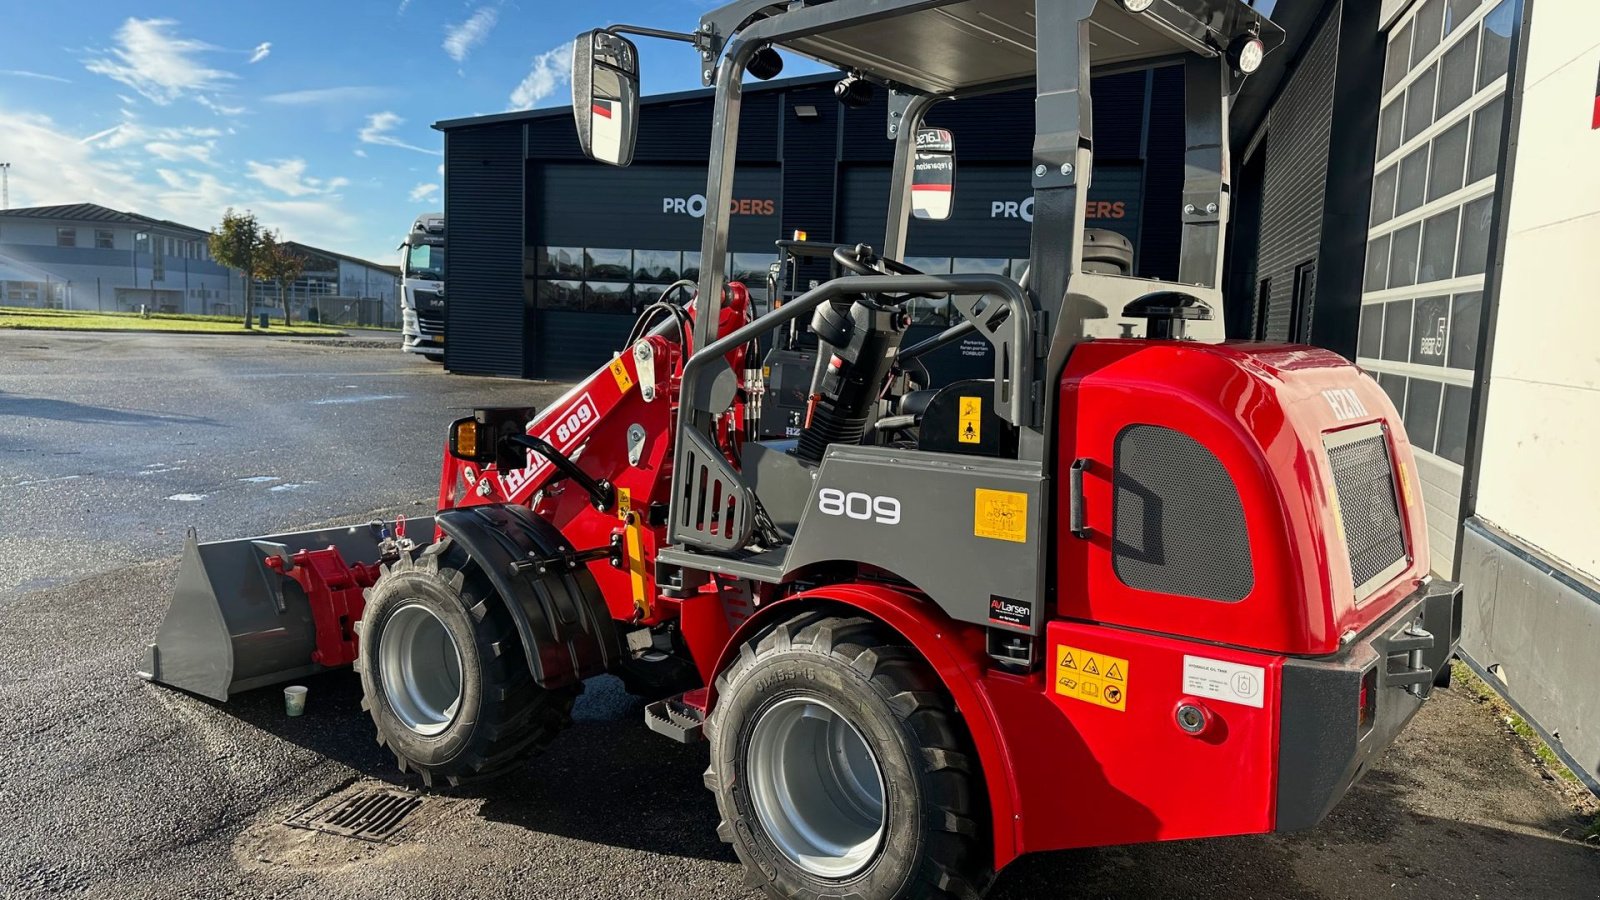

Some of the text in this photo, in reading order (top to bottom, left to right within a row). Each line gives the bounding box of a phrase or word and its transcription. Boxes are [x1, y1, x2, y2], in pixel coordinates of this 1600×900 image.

[1434, 317, 1446, 355] 5
[556, 404, 592, 443] 809
[1321, 389, 1368, 420] HZM
[785, 426, 801, 436] HZ
[819, 487, 901, 525] 809
